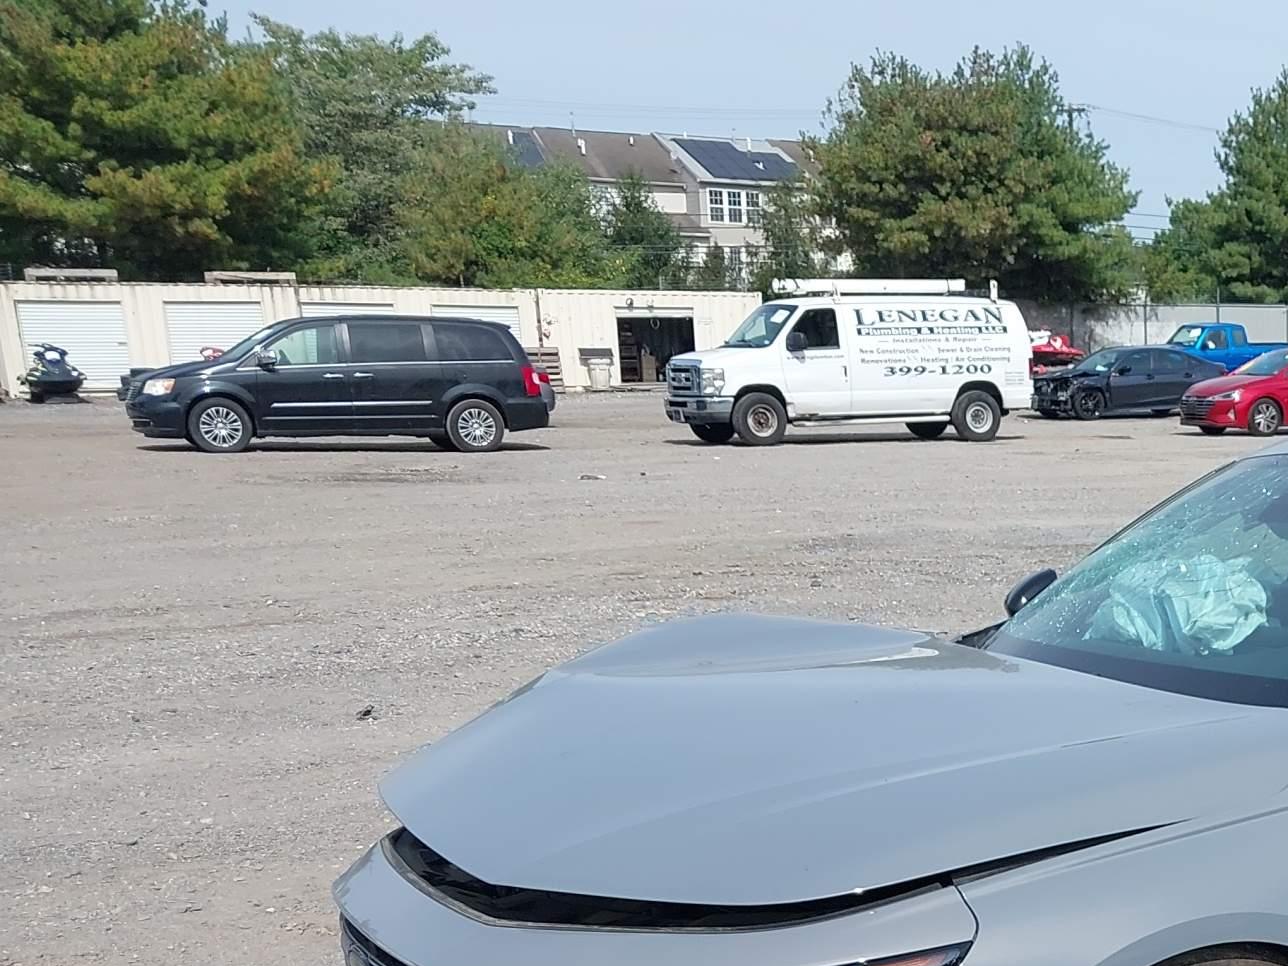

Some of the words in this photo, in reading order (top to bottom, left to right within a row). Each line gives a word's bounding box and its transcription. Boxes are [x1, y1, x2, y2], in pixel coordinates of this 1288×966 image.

[853, 307, 1003, 326] LENEGAN
[861, 327, 918, 336] Plumbing
[921, 327, 931, 335] &
[934, 326, 980, 335] Heating
[982, 326, 1004, 334] LLC
[884, 364, 992, 376] 399-1200
